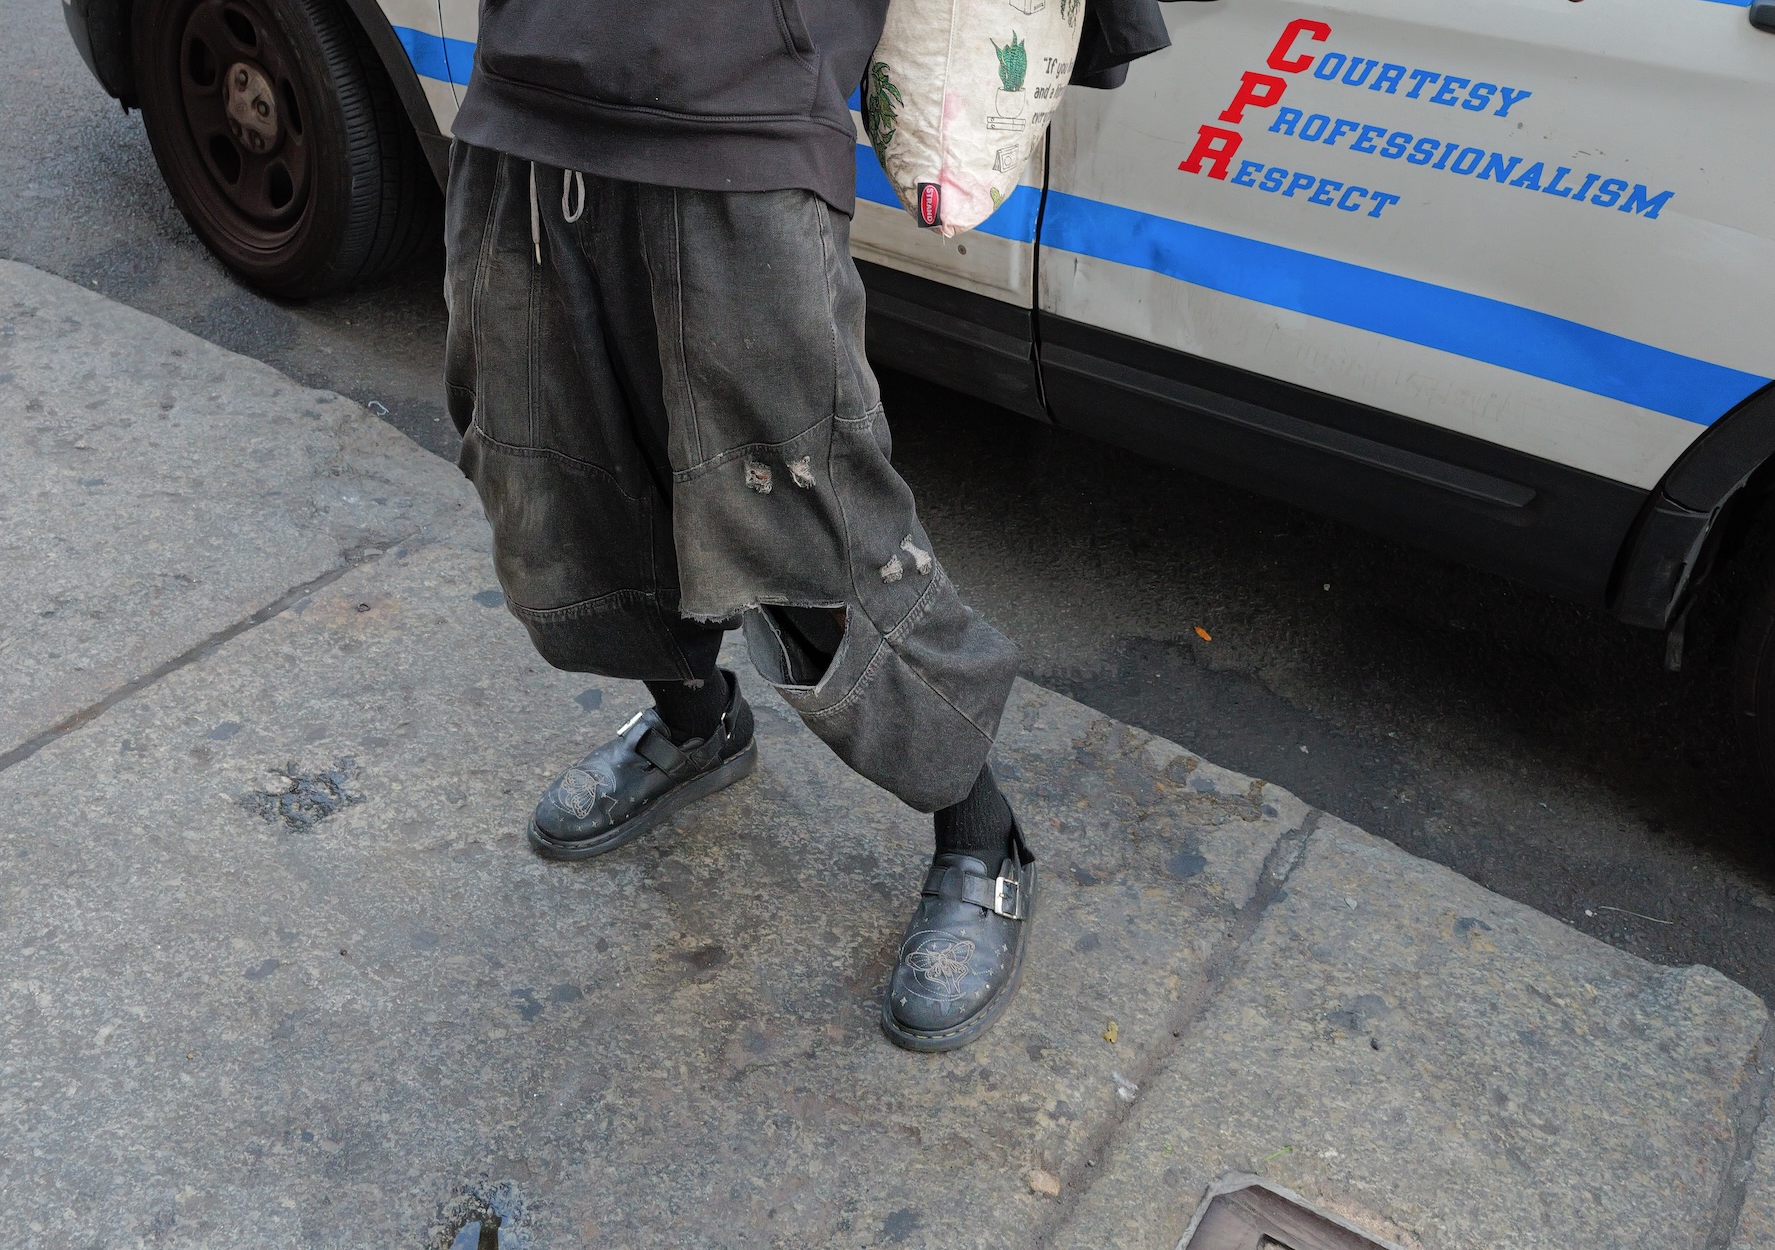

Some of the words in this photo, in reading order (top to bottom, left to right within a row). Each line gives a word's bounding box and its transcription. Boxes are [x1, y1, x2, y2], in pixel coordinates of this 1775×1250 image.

[1034, 83, 1051, 99] and
[1266, 18, 1531, 118] COURTESY
[1177, 124, 1401, 219] RESPECT
[1218, 71, 1675, 220] PROFESSIONALISM
[926, 187, 934, 222] STRAND
